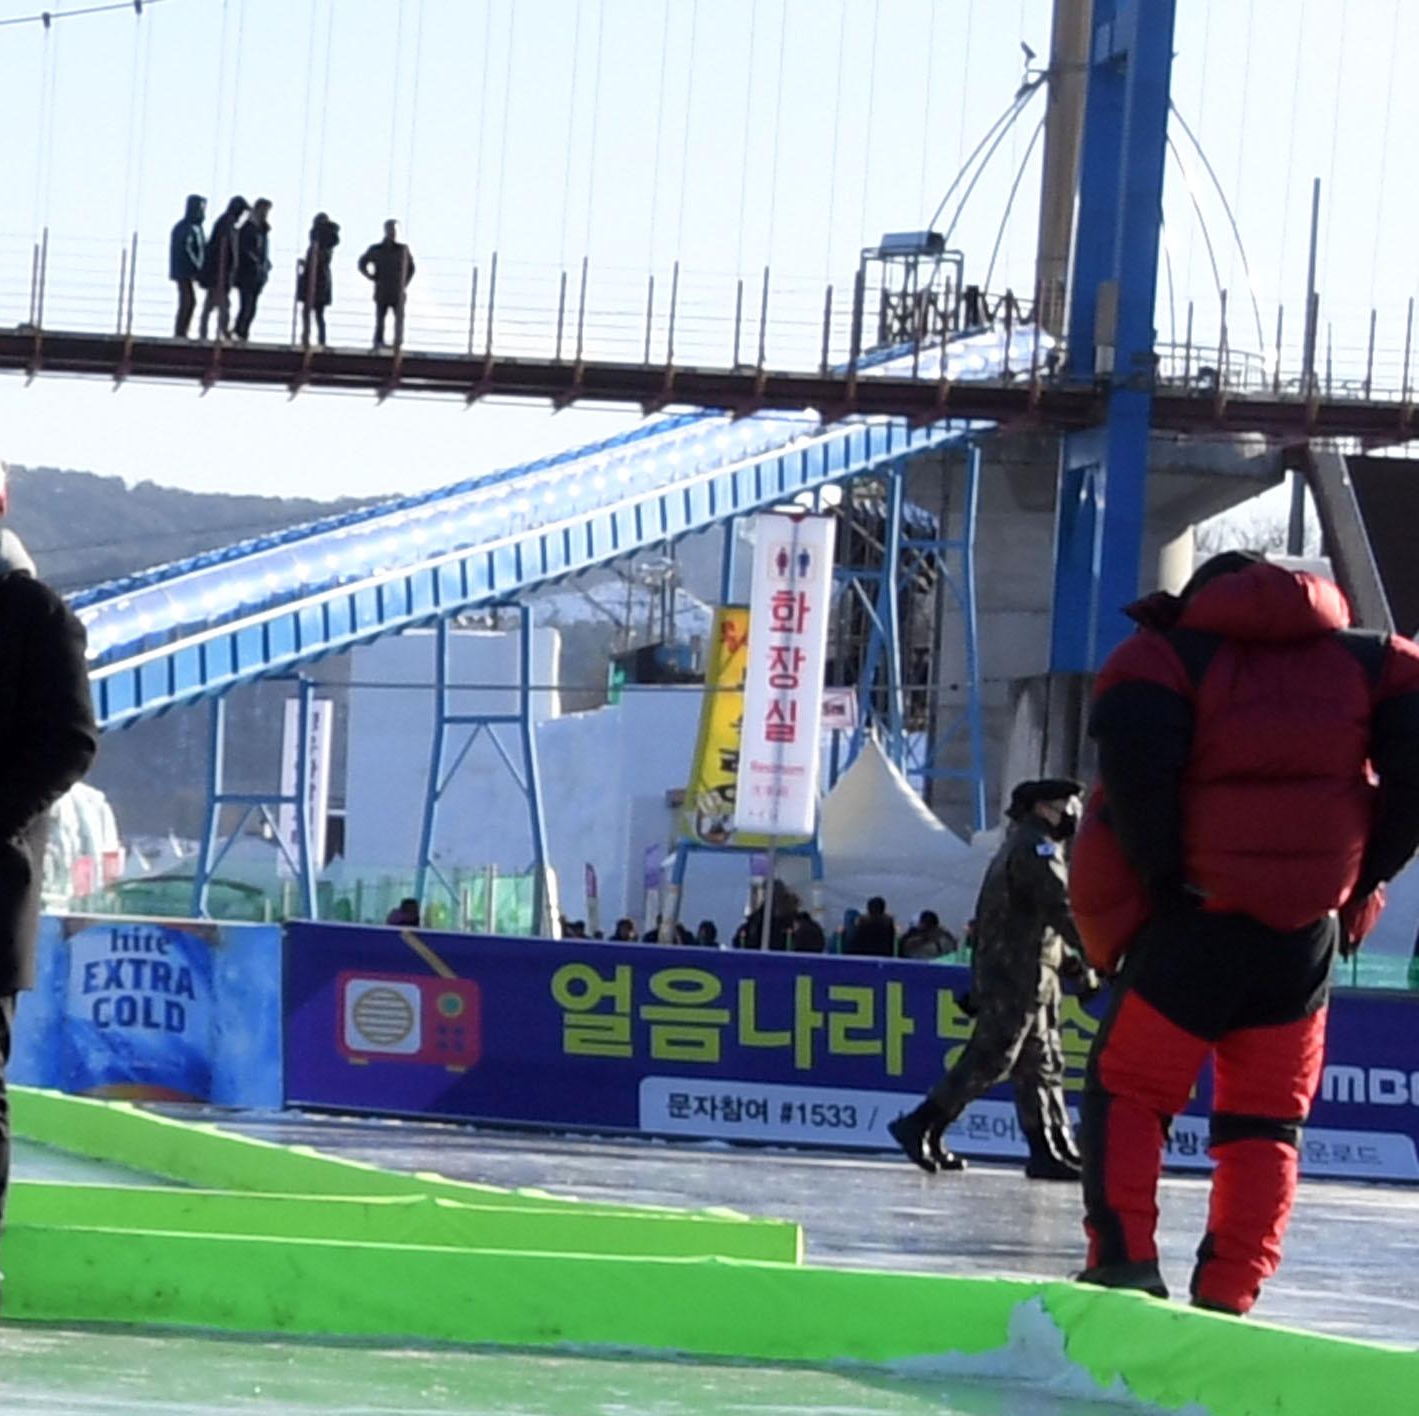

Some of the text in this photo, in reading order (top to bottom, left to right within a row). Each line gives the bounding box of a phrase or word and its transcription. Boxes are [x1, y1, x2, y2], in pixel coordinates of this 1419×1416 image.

[765, 590, 811, 744] 화장실
[111, 927, 171, 955] hite
[83, 957, 195, 1000] EXTRA
[92, 995, 186, 1034] COLD
[551, 963, 915, 1076] 얼음나라
[1321, 1065, 1419, 1107] MB
[668, 1092, 769, 1124] 문자참여
[780, 1101, 858, 1128] #1533
[1306, 1140, 1384, 1166] 운로드
